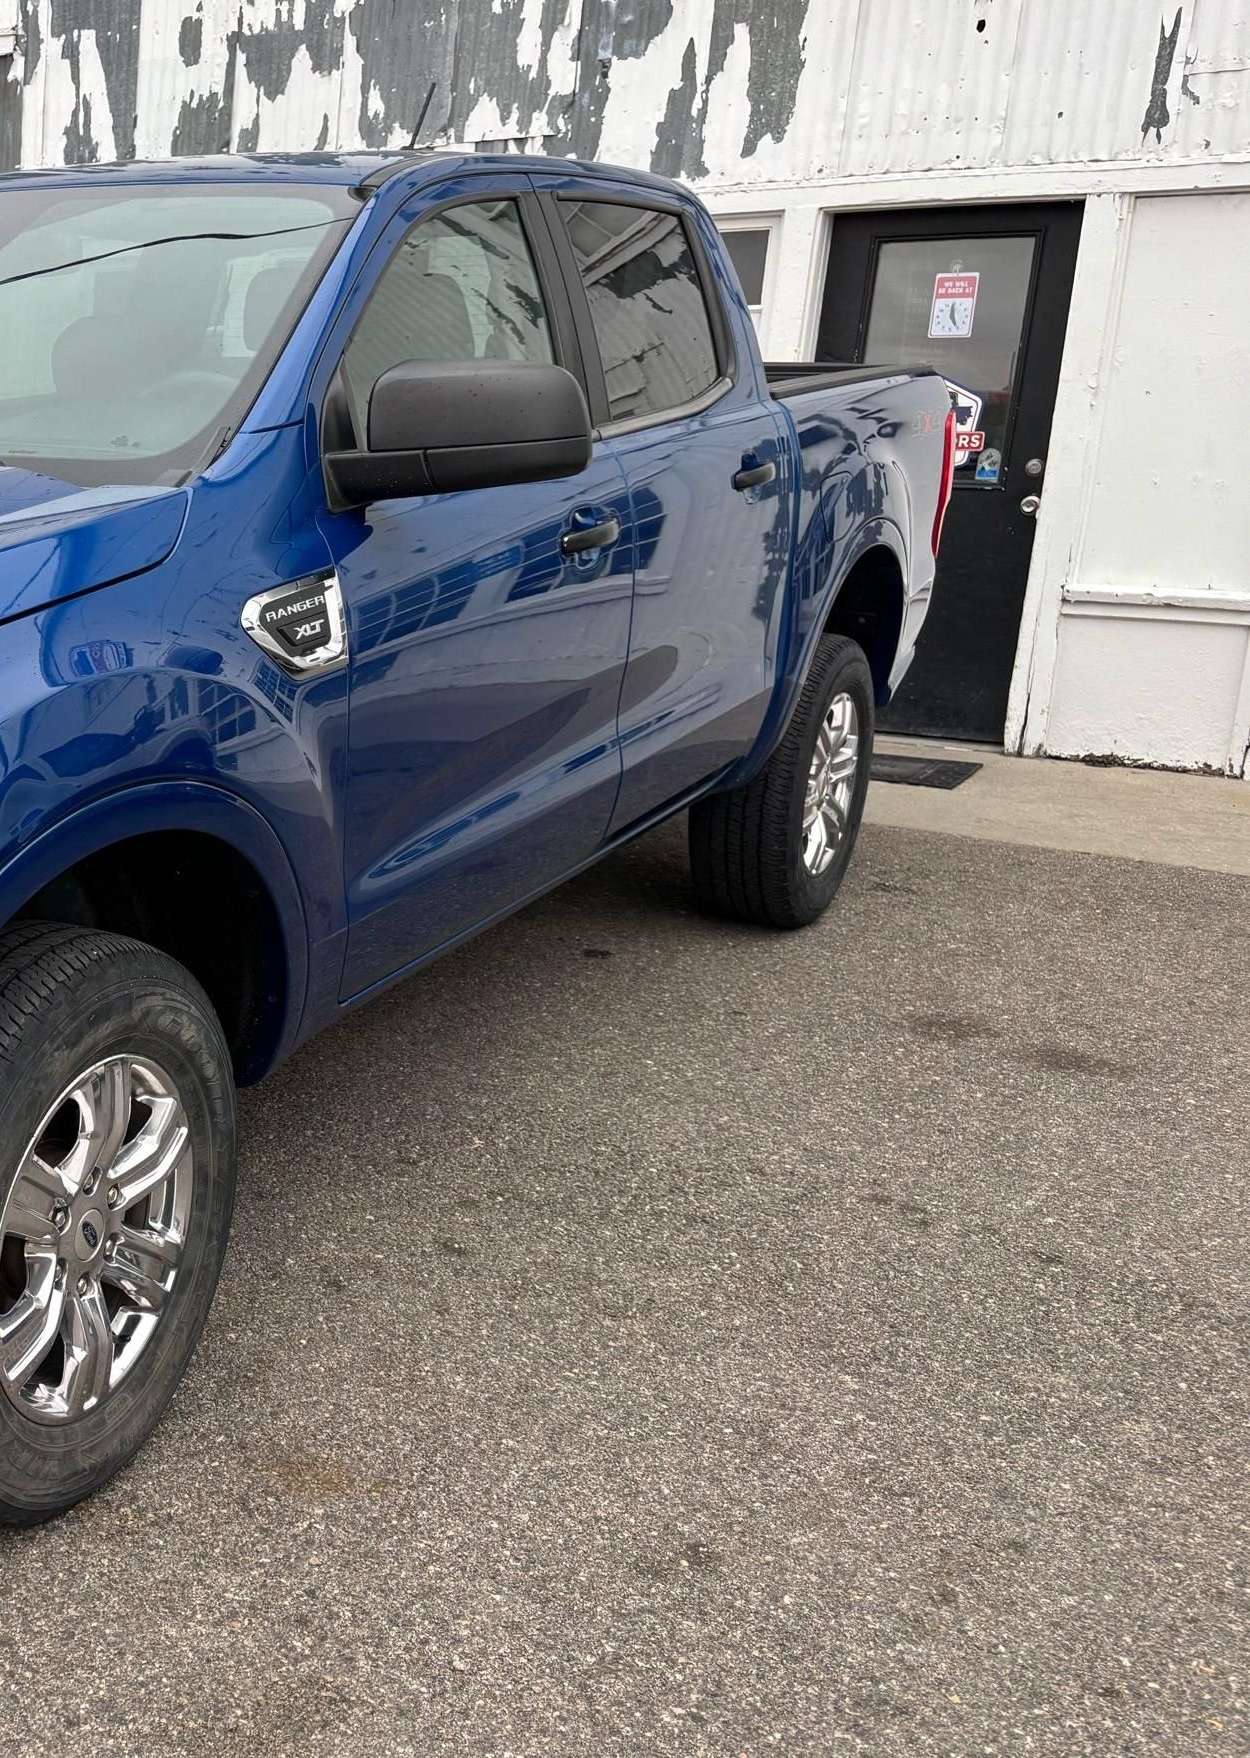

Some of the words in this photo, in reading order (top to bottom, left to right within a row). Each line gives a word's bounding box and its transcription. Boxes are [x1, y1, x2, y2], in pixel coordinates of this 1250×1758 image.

[957, 434, 981, 448] RS
[265, 594, 325, 622] RANGER
[293, 618, 325, 640] XLT
